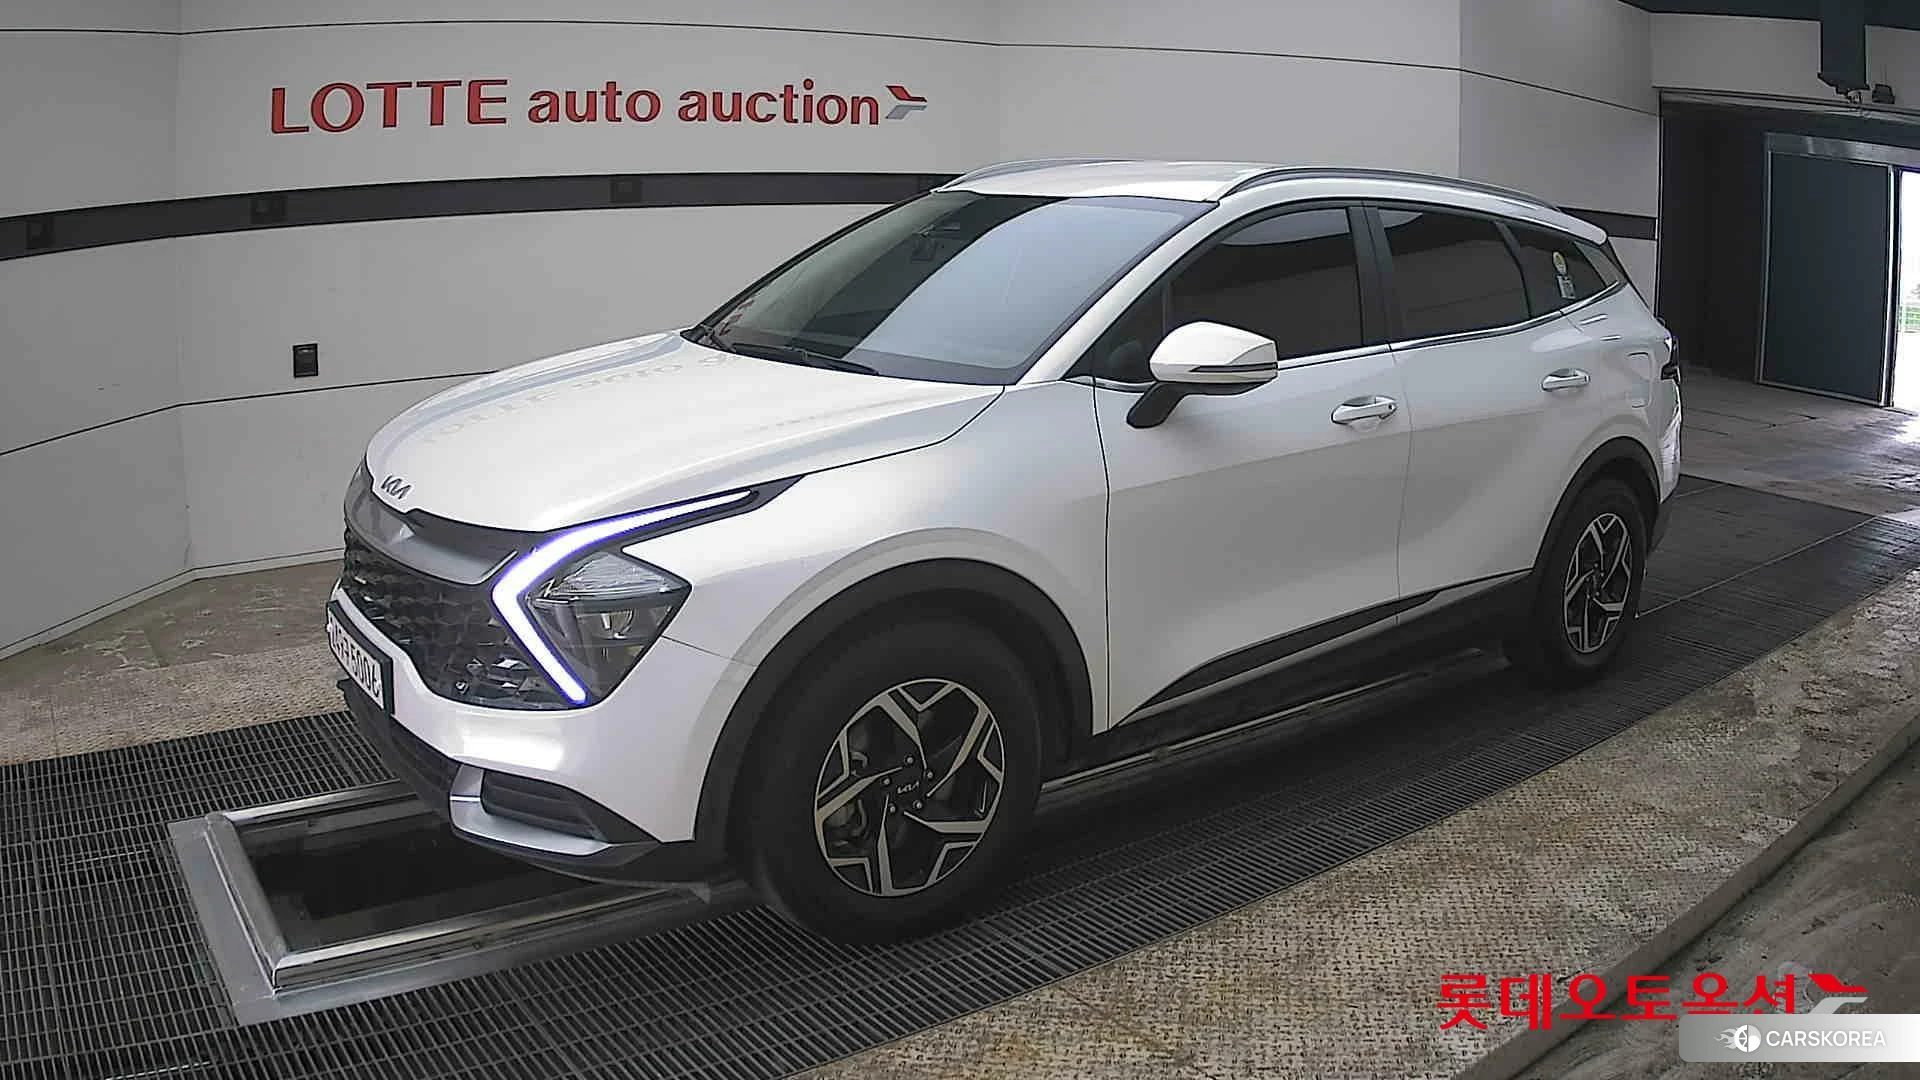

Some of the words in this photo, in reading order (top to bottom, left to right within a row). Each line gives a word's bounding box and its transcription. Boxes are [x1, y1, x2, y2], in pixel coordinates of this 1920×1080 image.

[271, 79, 508, 134] LOTTE
[528, 81, 662, 124] auto
[677, 79, 879, 125] auction
[380, 475, 411, 500] KIA
